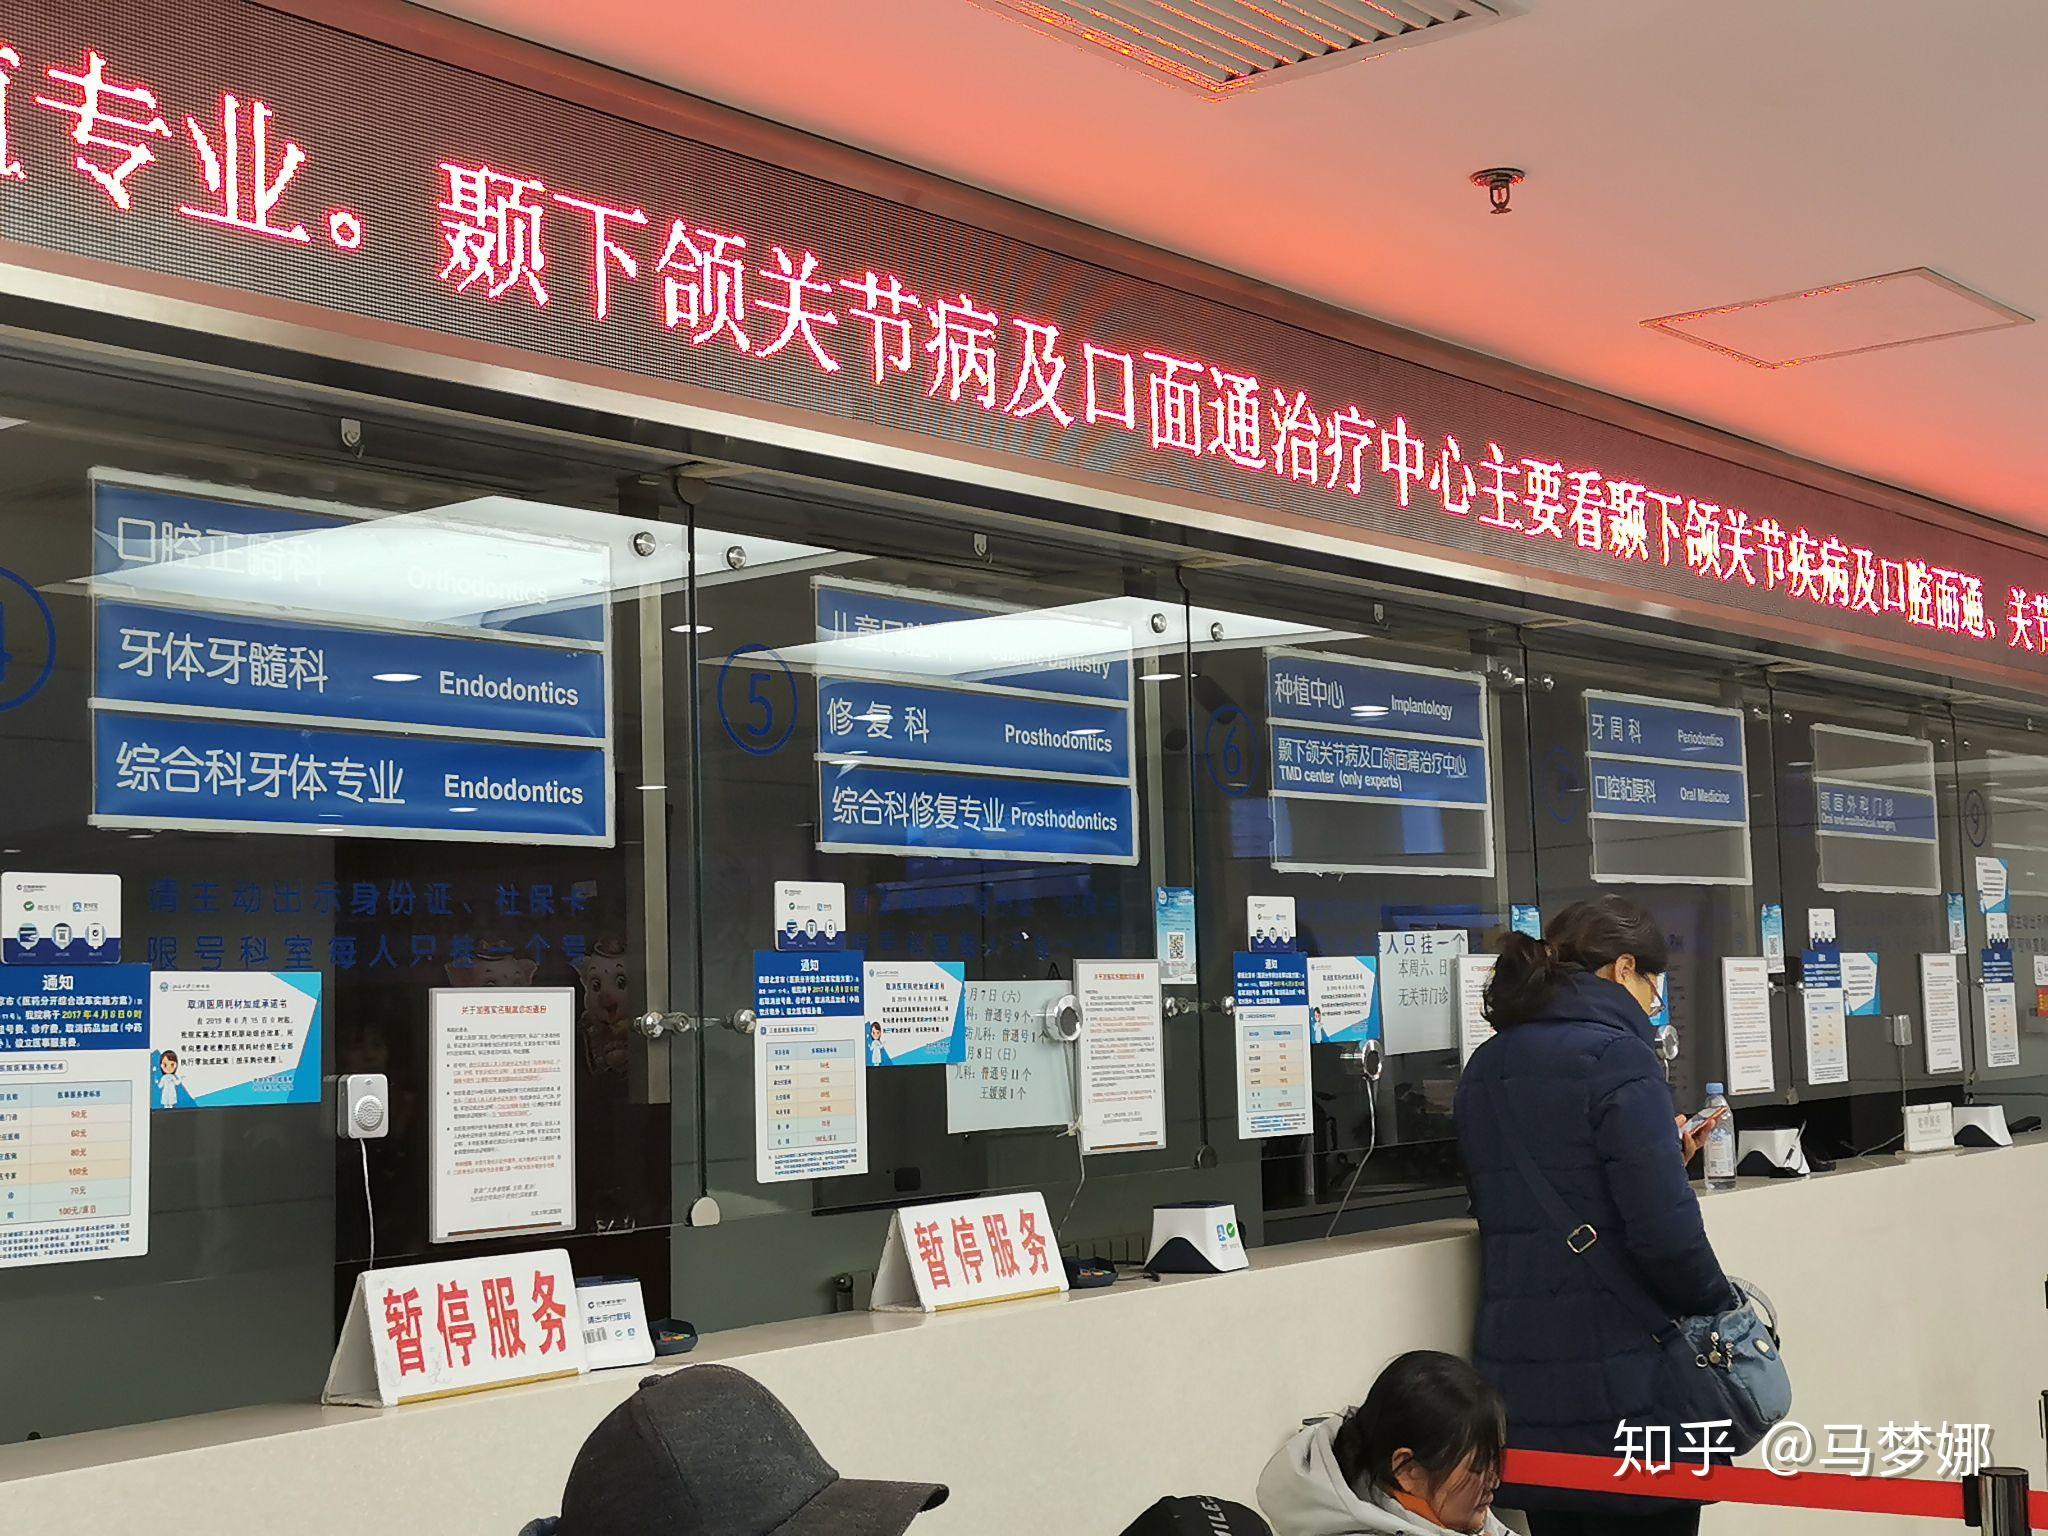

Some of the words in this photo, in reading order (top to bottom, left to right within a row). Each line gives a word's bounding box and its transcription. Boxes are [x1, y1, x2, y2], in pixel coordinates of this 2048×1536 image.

[0, 46, 363, 251] 专业。
[119, 626, 329, 693] 牙体牙髓科
[439, 670, 579, 706] Endodontics
[1048, 650, 1111, 681] Dentistry
[745, 673, 773, 736] 5
[1274, 673, 1345, 709] 种植中心
[1391, 694, 1453, 721] Implantology
[827, 696, 930, 744] 修复科
[1005, 723, 1112, 753] Prosthodontics
[1591, 713, 1642, 744] 牙周科
[116, 741, 406, 805] 综合科牙体专业
[444, 774, 584, 806] Endodontics
[1279, 764, 1303, 781] TMD
[1304, 770, 1335, 784] center
[1340, 769, 1363, 789] (only
[1364, 773, 1403, 791] experts)
[831, 785, 1006, 832] 综合科修复专业
[1011, 806, 1118, 833] Prosthodontics
[1680, 786, 1697, 801] Oral
[149, 879, 588, 917] 请主动出示身份证、社保卡
[148, 934, 587, 970] 限号科室每人只挂一个号
[1398, 958, 1447, 979] 本周六、日
[42, 974, 75, 991] 通知
[1398, 986, 1449, 1007] 无关节门诊
[187, 999, 287, 1009] 取消医用耗材加成承诺书
[913, 1208, 1051, 1291] 暂停服务
[382, 1269, 567, 1377] 暂停服务
